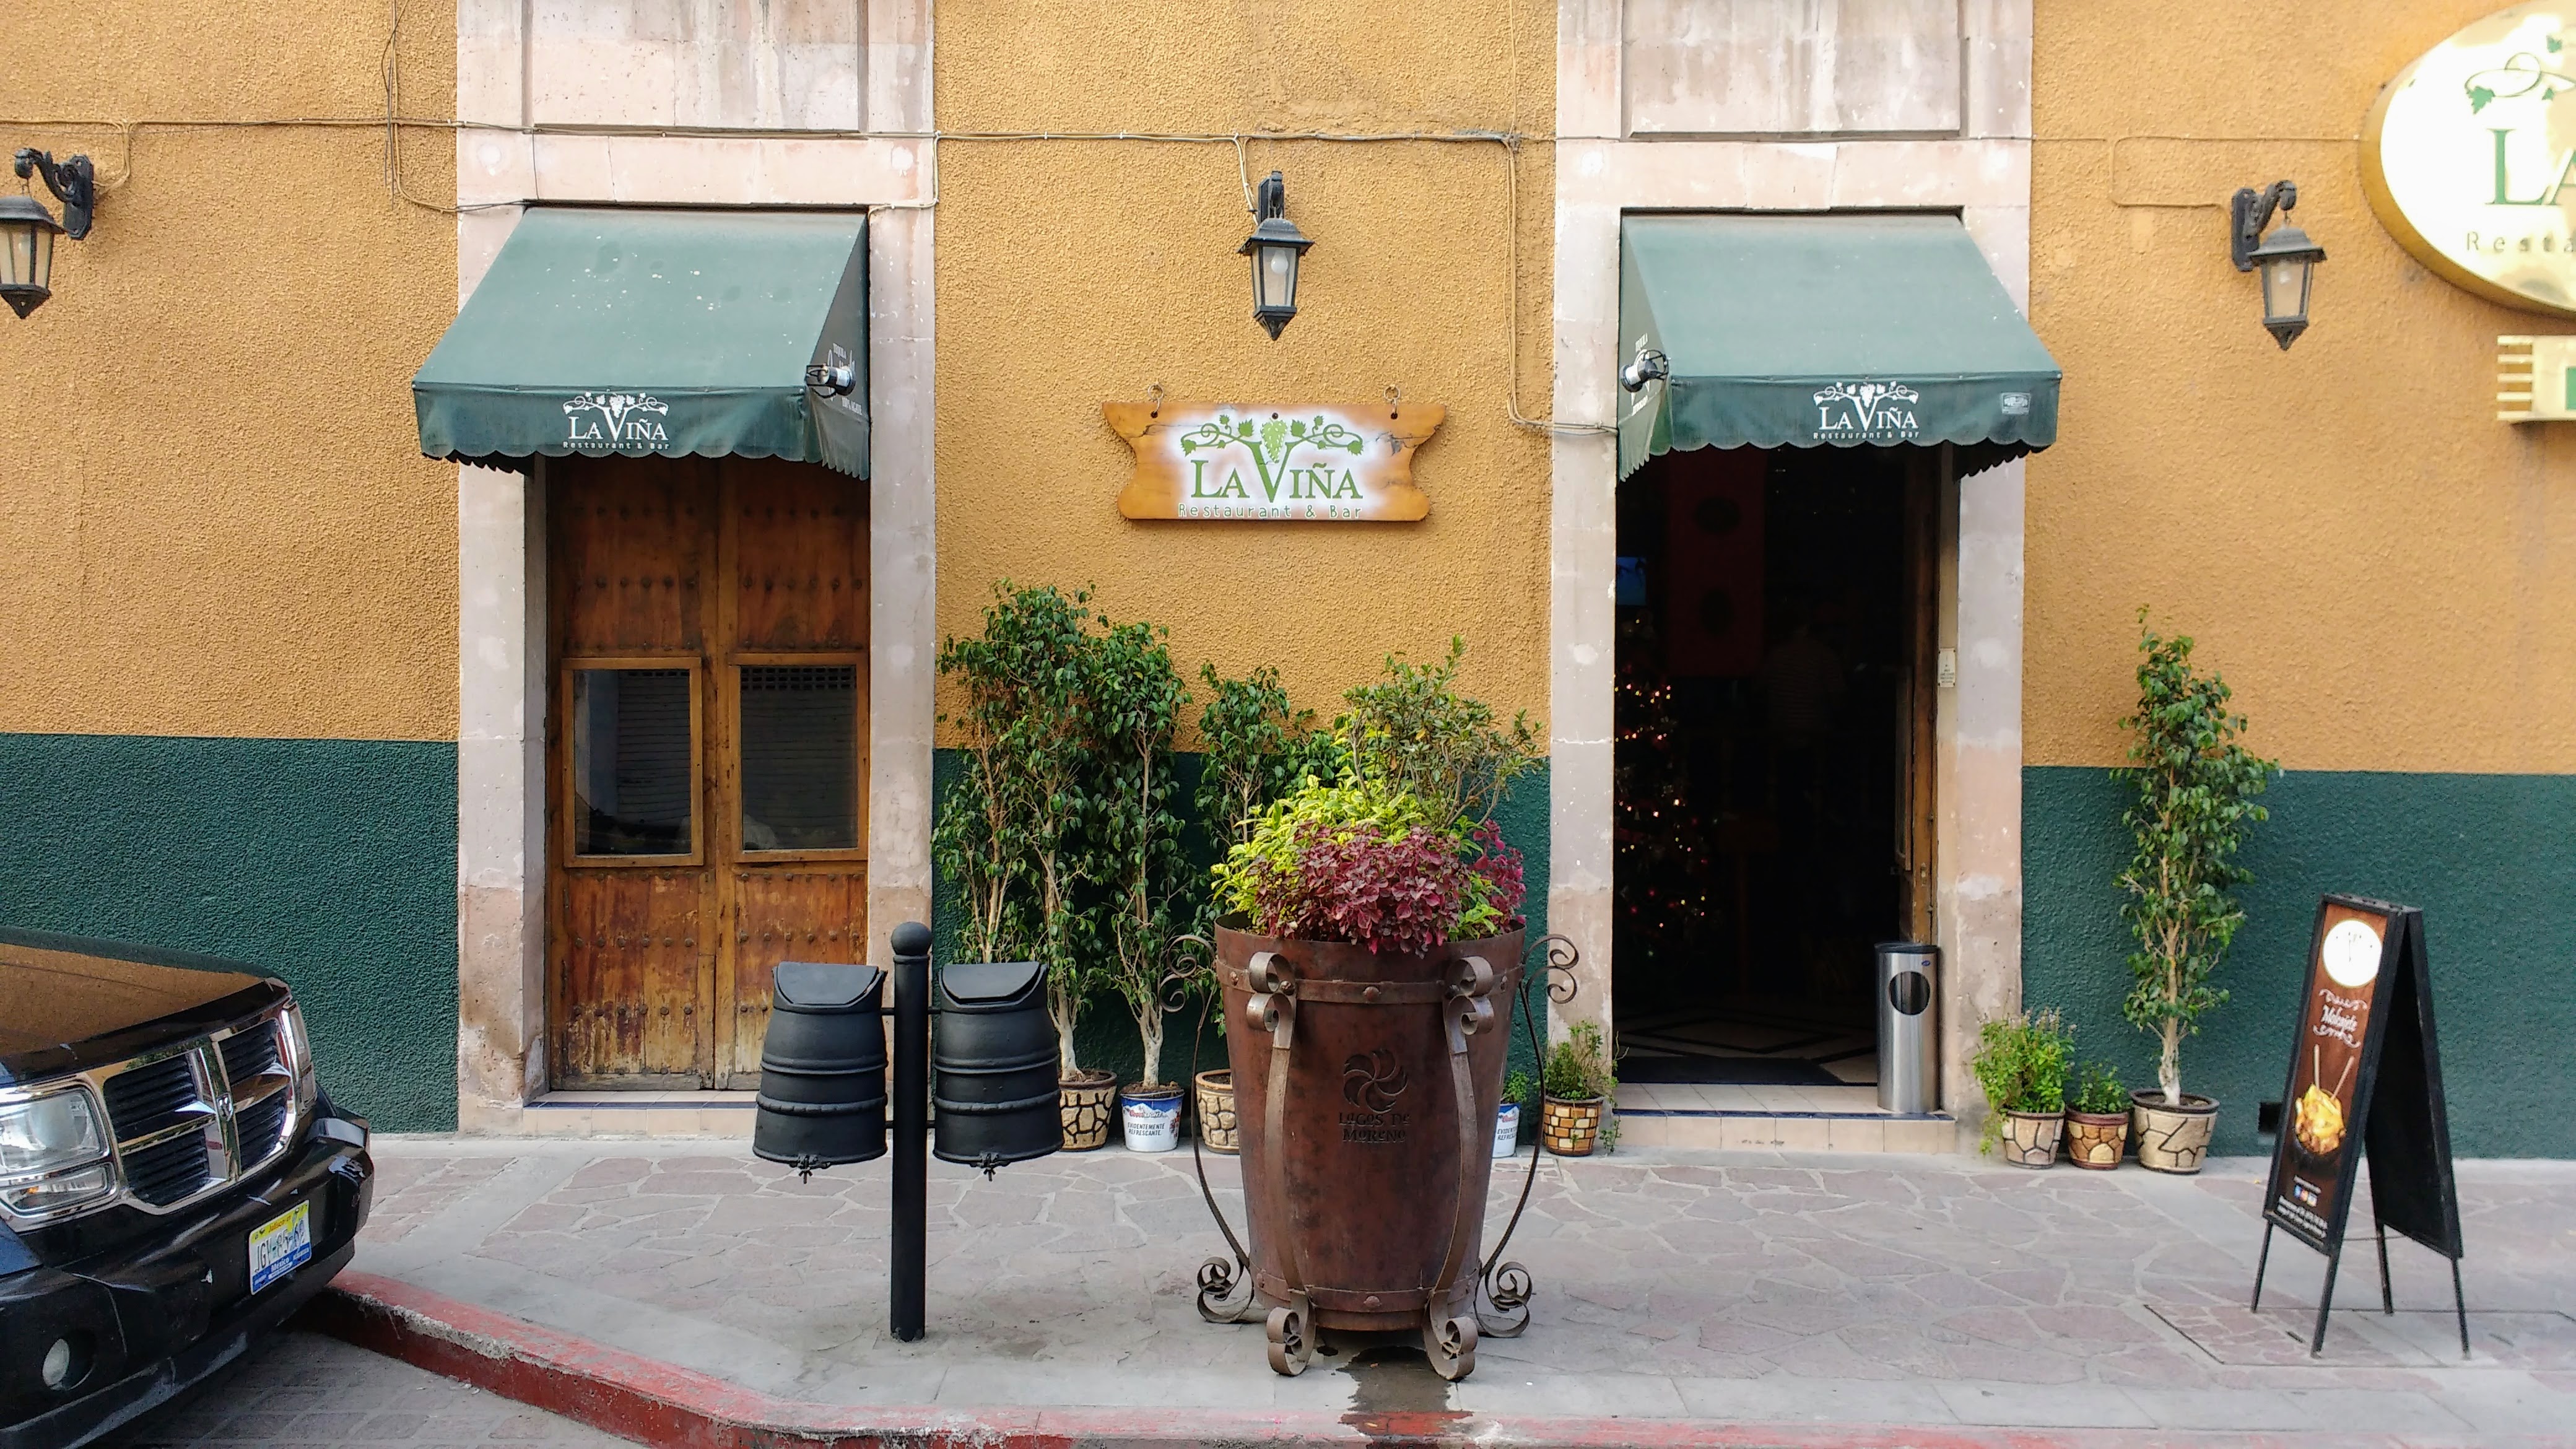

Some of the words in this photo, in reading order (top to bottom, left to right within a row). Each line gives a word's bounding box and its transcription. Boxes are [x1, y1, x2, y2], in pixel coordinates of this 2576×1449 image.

[568, 416, 604, 440] LA
[602, 407, 669, 442] VIÑA
[1818, 406, 1854, 430] LA
[1852, 396, 1918, 432] VIÑA
[563, 441, 631, 449] Restaurant
[650, 442, 669, 450] Bar
[1190, 459, 1250, 498] LA
[1246, 441, 1363, 503] VIÑA
[1178, 503, 1292, 518] Restaurant
[1305, 504, 1316, 518] &
[1329, 503, 1362, 519] Bar
